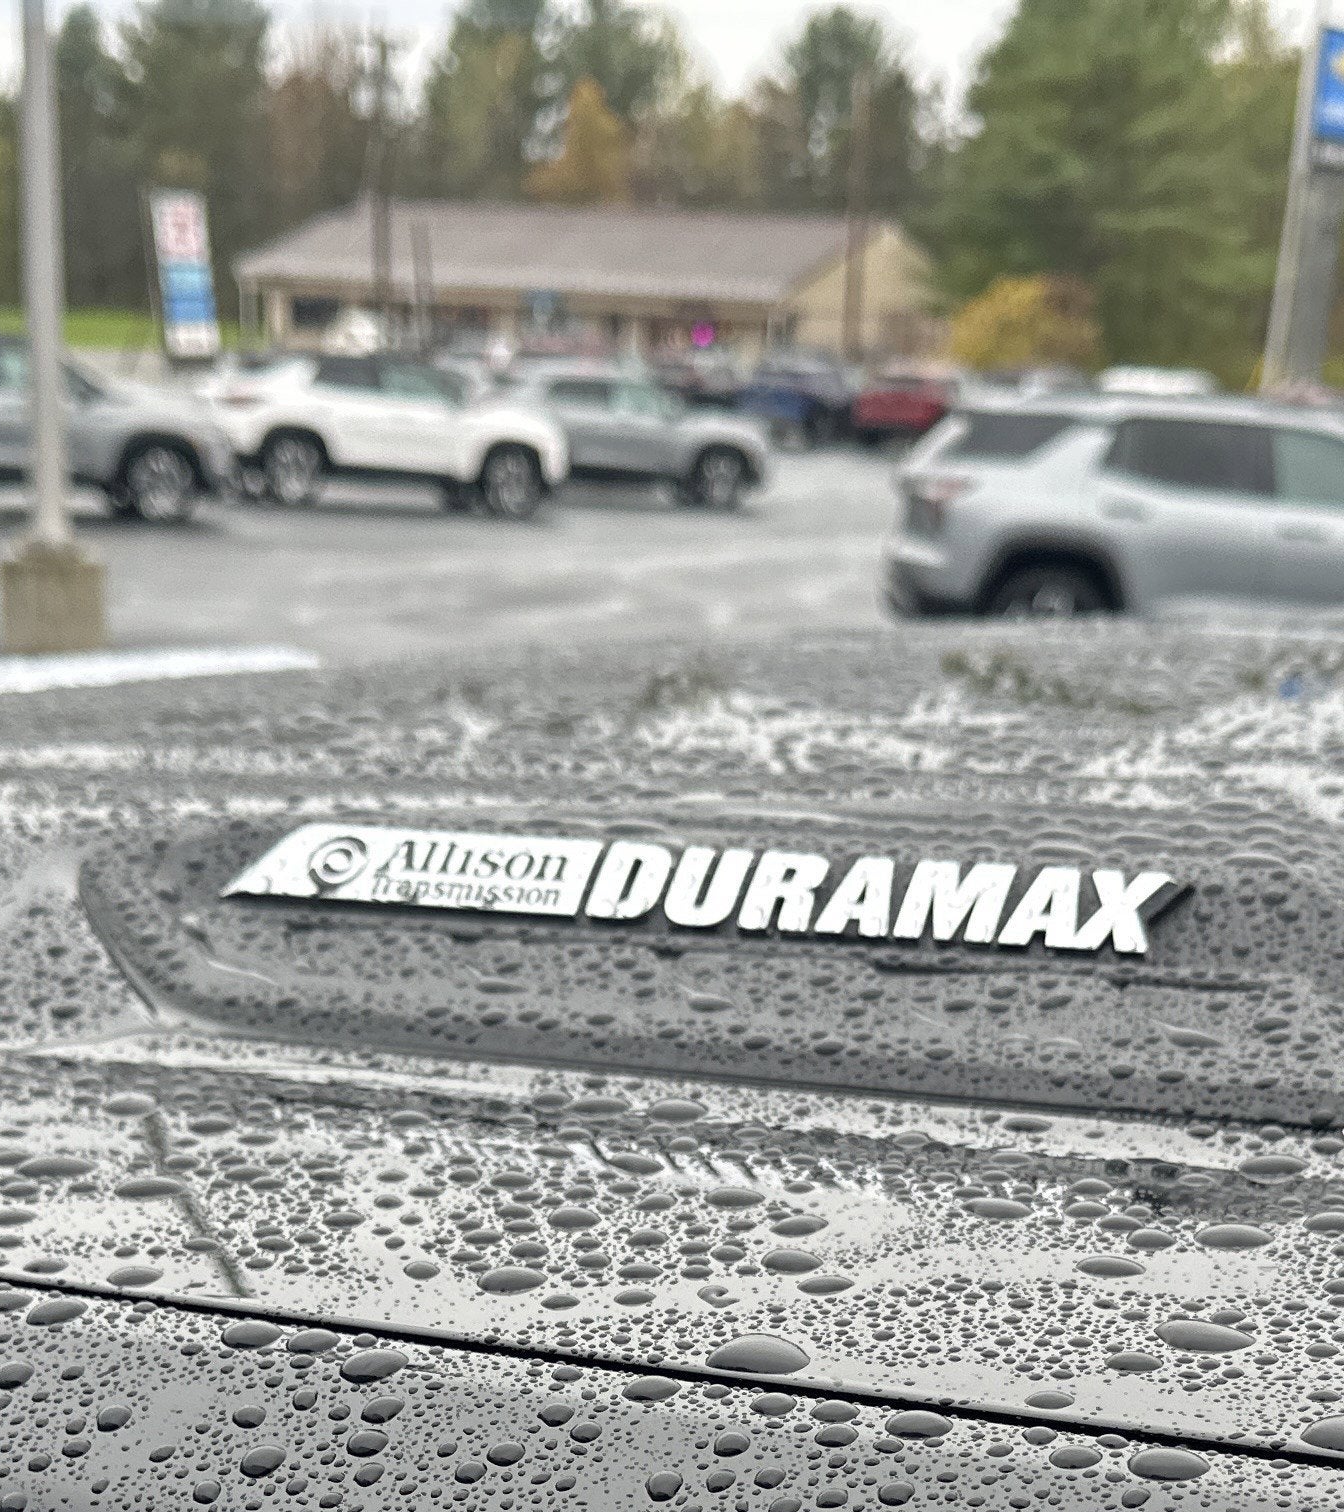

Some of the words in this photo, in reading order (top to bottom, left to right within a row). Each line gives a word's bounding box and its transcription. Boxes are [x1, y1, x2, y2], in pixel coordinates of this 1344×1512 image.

[372, 839, 569, 882] Allison
[371, 872, 562, 908] Transmission
[585, 838, 1179, 955] DURAMAX
